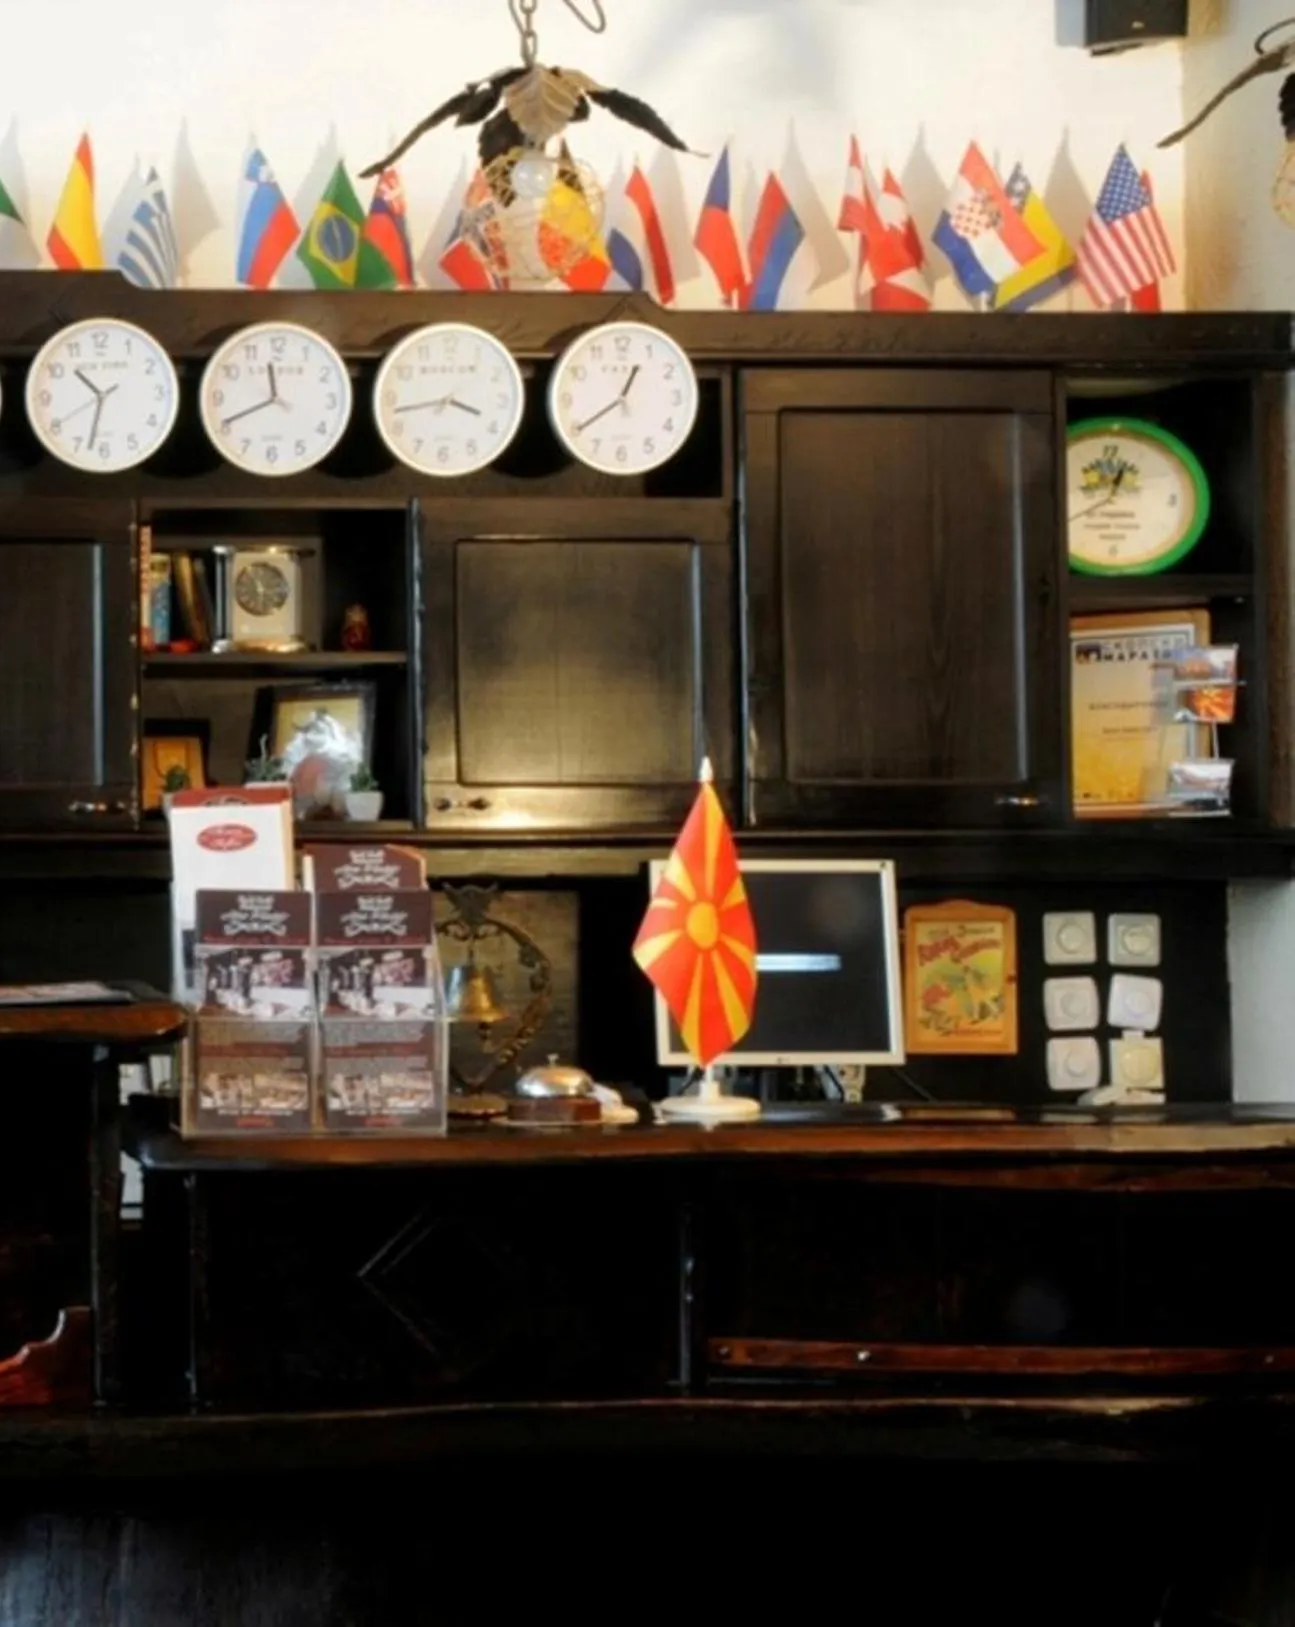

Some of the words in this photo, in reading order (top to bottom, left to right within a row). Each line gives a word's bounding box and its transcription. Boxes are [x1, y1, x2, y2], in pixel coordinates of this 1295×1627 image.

[91, 332, 109, 348] 12
[125, 339, 132, 356] 1
[270, 337, 286, 354] 12
[614, 336, 632, 352] 12
[68, 342, 80, 357] 11
[244, 345, 257, 361] 11
[302, 345, 309, 361] 1
[590, 344, 602, 360] 11
[646, 344, 653, 359] 1
[48, 362, 65, 378] 10
[145, 359, 156, 375] 2
[223, 364, 240, 381] 10
[248, 366, 304, 376] LODON
[320, 366, 331, 383] 2
[570, 365, 587, 381] 10
[663, 362, 674, 380] 2
[39, 390, 51, 407] 9
[154, 385, 165, 401] 3
[213, 390, 223, 406] 9
[561, 391, 572, 408] 9
[671, 390, 681, 407] 3
[325, 393, 336, 410] 3
[50, 419, 61, 436] 8
[146, 413, 157, 427] 4
[315, 420, 327, 435] 4
[662, 417, 673, 431] 4
[72, 436, 83, 453] 7
[127, 433, 139, 450] 5
[241, 438, 251, 454] 7
[295, 440, 306, 456] 5
[591, 438, 601, 454] 7
[643, 437, 655, 455] 5
[99, 442, 111, 459] 6
[266, 446, 278, 463] 6
[616, 445, 627, 462] 6
